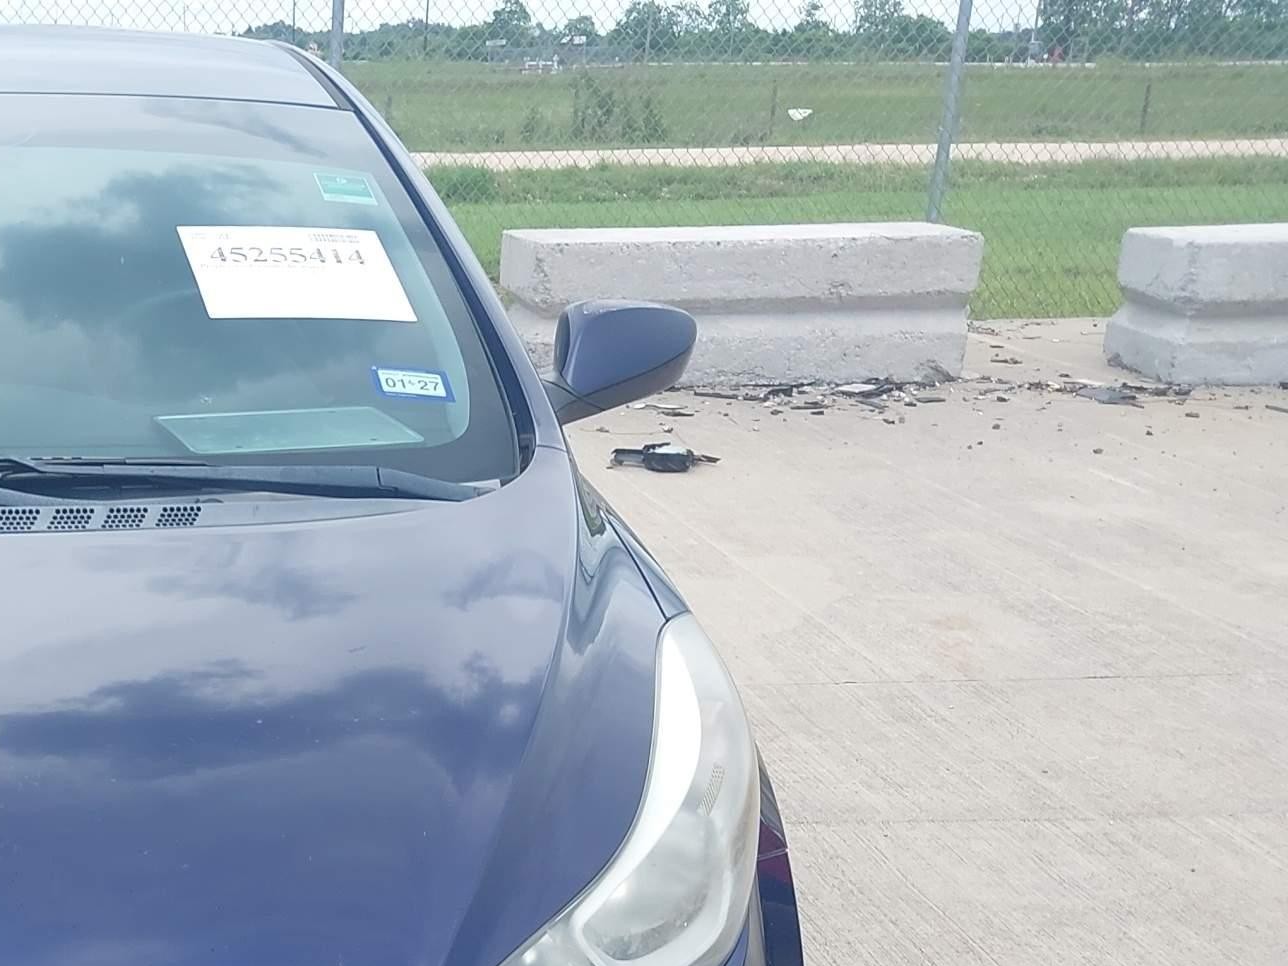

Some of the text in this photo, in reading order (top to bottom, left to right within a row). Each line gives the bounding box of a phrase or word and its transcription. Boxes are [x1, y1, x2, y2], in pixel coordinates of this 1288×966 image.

[209, 246, 365, 265] 45255414
[385, 377, 440, 392] 01 27
